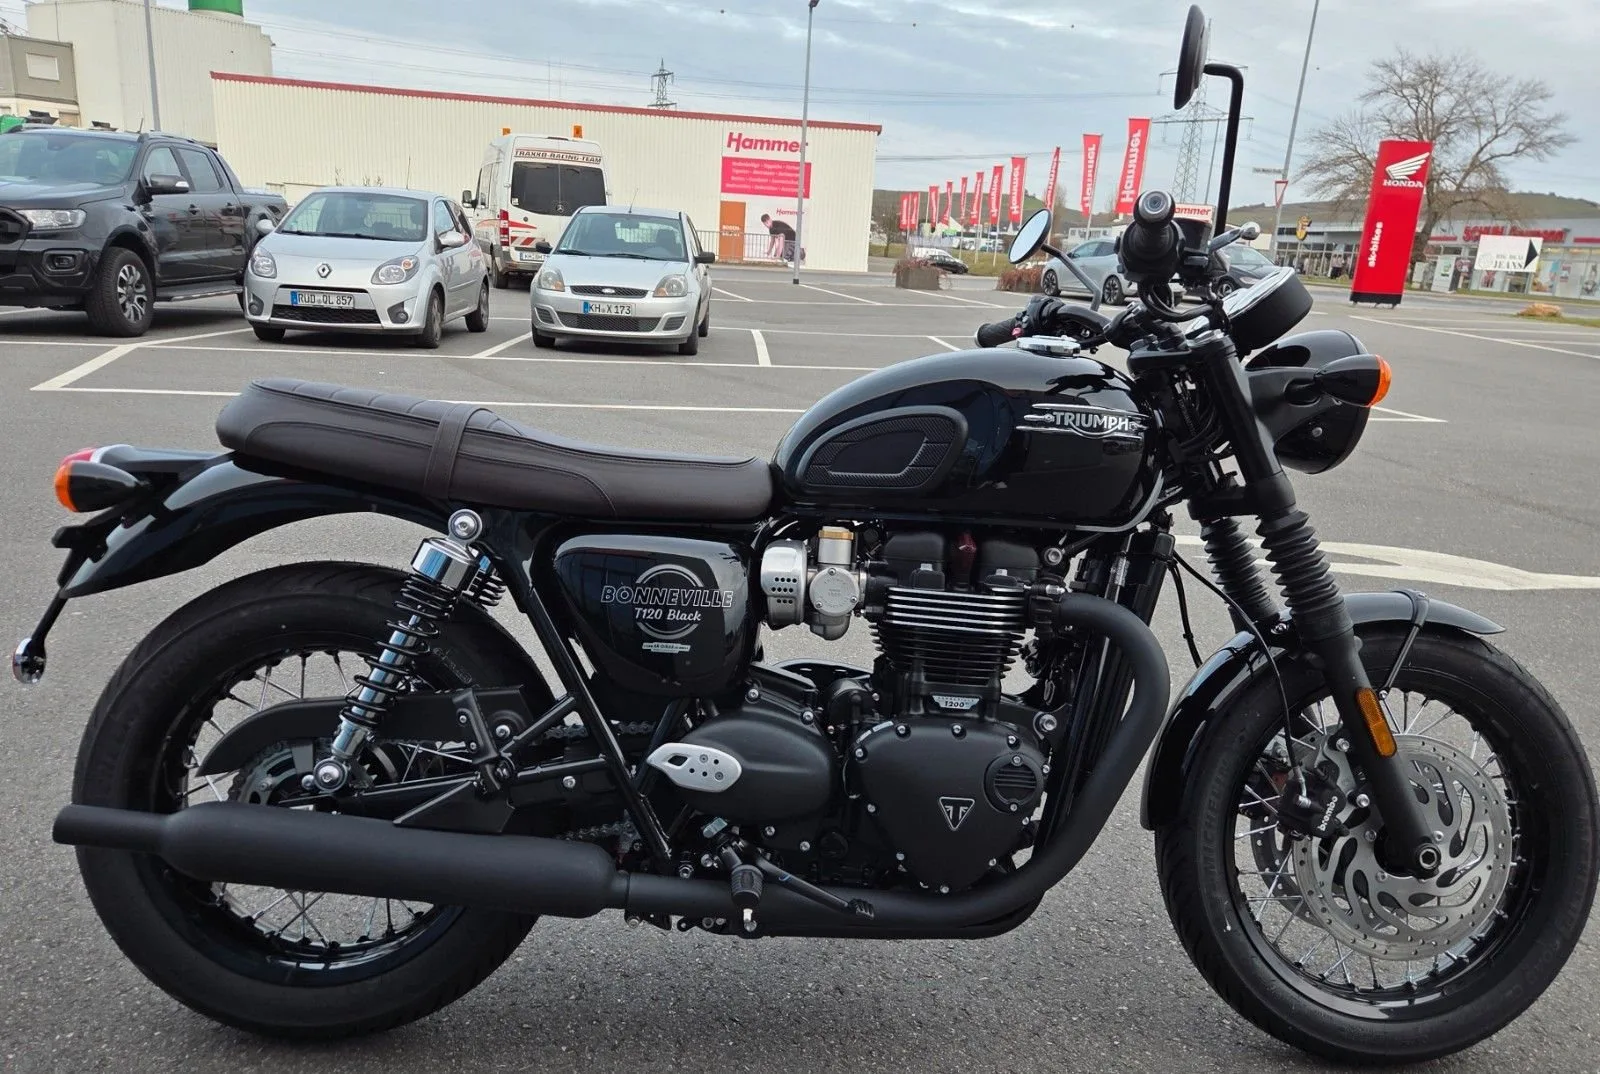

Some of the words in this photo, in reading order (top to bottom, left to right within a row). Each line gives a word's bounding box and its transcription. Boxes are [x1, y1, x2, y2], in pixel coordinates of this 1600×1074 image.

[1382, 179, 1424, 188] HONDA
[1174, 207, 1211, 216] ammer
[1367, 221, 1384, 268] sk-bikes
[322, 294, 334, 305] QL
[336, 295, 353, 306] 857
[590, 303, 601, 313] KH
[606, 304, 612, 313] X
[614, 305, 631, 315] 173
[1052, 411, 1129, 433] TRIUMPH
[601, 585, 734, 608] BONNEVILLE
[634, 607, 663, 620] T120
[667, 608, 702, 622] Black
[1317, 795, 1339, 832] brembo
